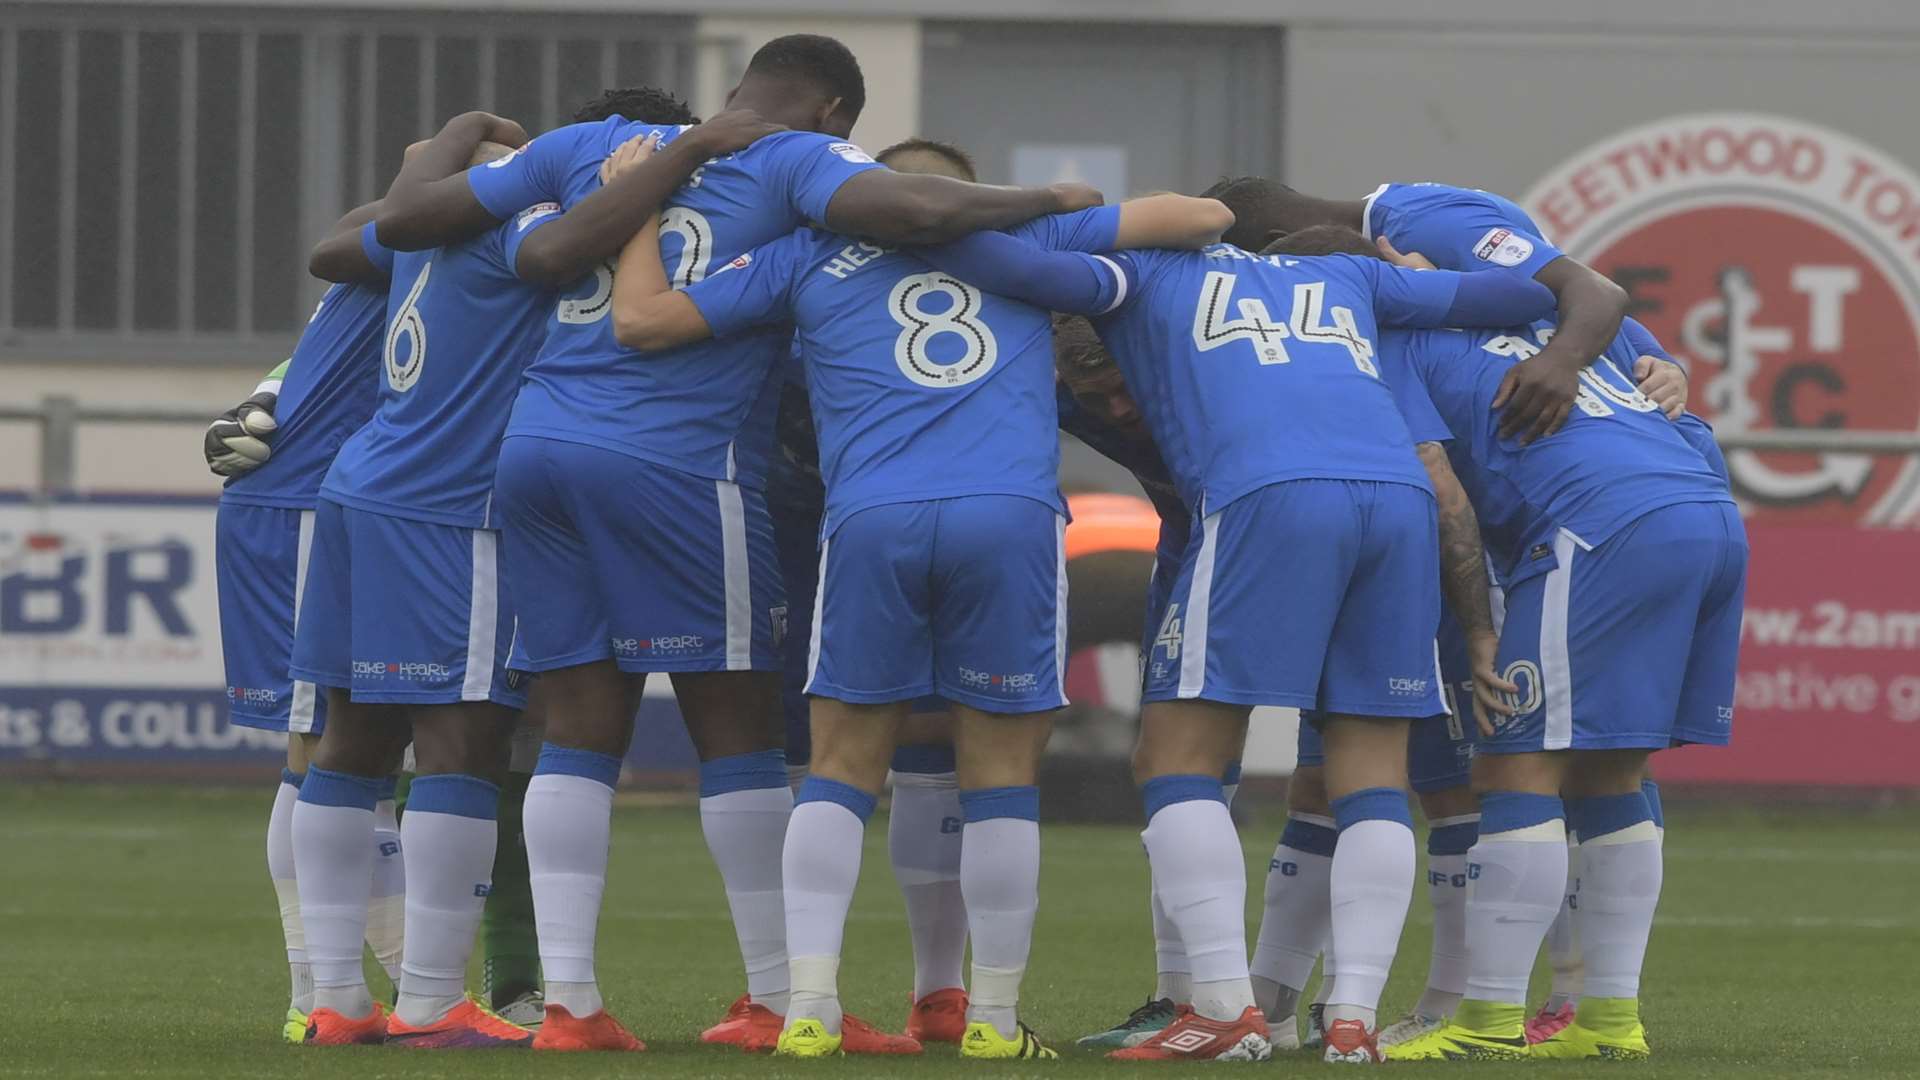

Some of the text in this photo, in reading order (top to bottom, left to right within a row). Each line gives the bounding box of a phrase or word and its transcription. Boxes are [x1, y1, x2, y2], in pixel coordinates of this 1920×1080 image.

[823, 241, 896, 279] HES
[385, 261, 427, 393] 6
[888, 271, 998, 388] 8
[1192, 271, 1379, 380] 44
[1791, 266, 1862, 352] T
[53, 700, 92, 748] &
[103, 701, 289, 749] COLL
[1736, 666, 1878, 713] ative
